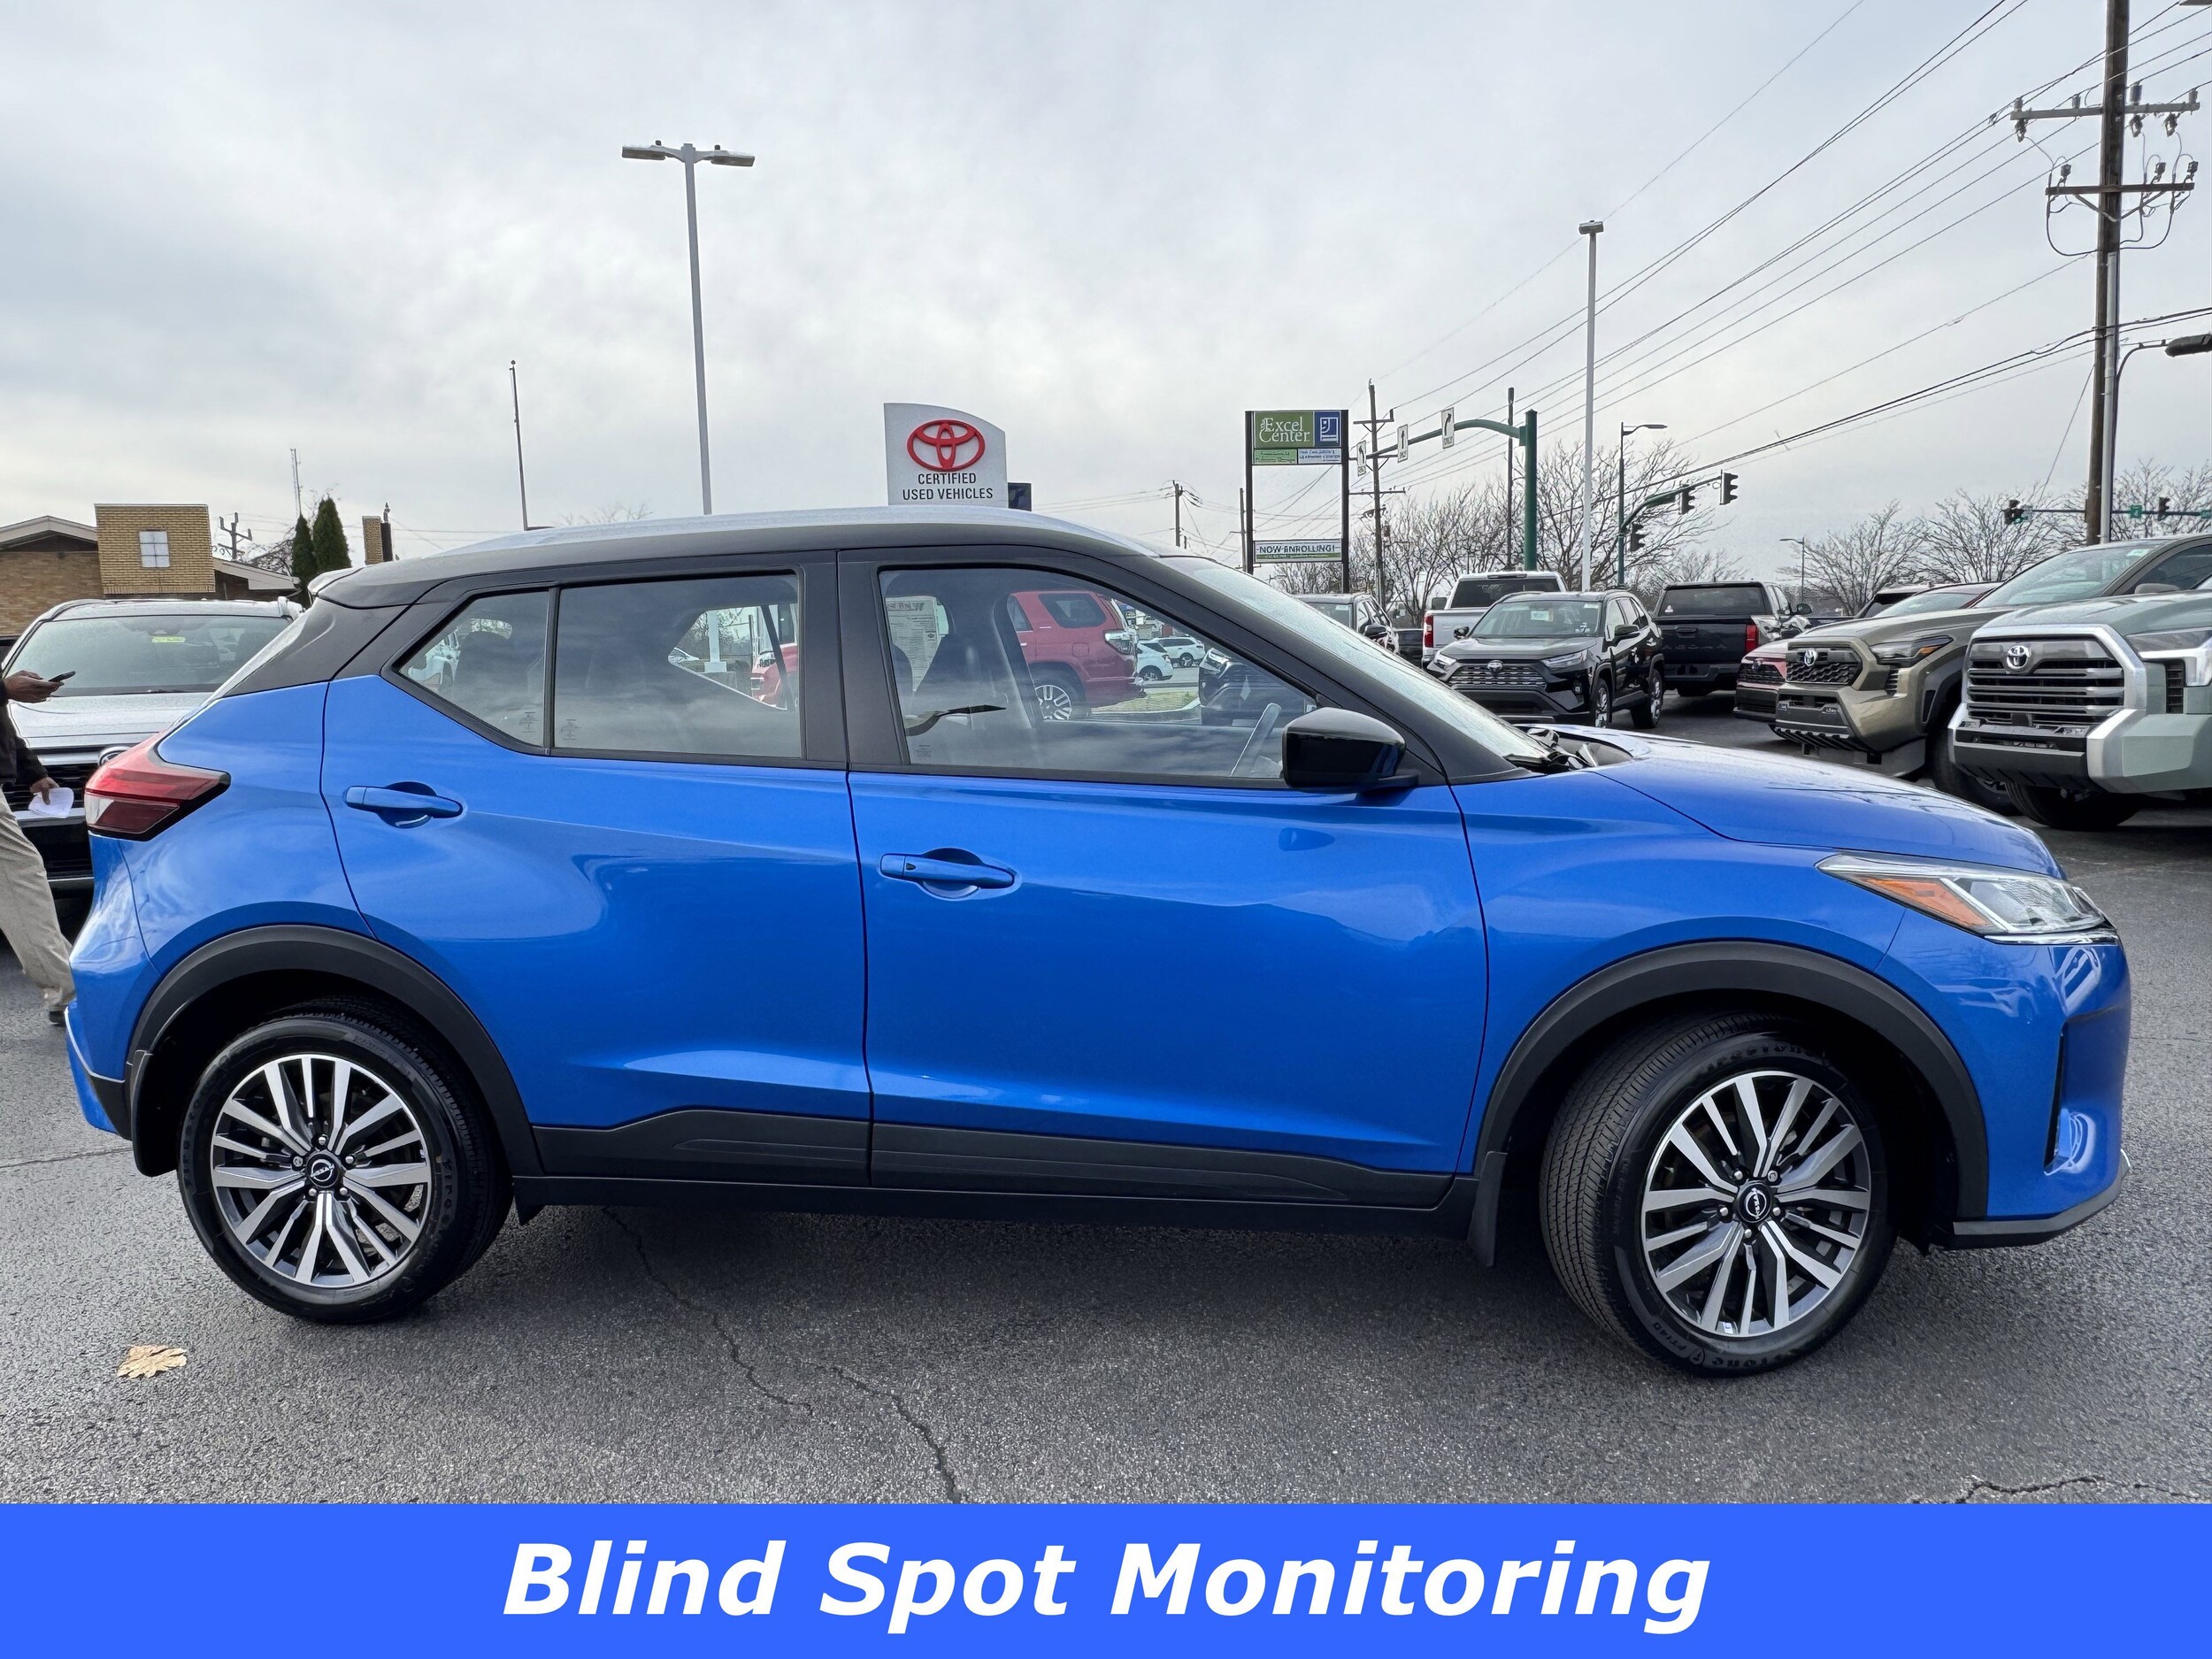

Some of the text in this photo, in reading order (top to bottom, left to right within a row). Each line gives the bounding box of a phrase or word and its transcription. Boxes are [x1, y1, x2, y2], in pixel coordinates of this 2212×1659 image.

[1263, 416, 1304, 432] Excel
[1259, 428, 1310, 442] Center
[918, 472, 977, 485] CERTIFIED
[902, 488, 994, 501] USED VEHICLES
